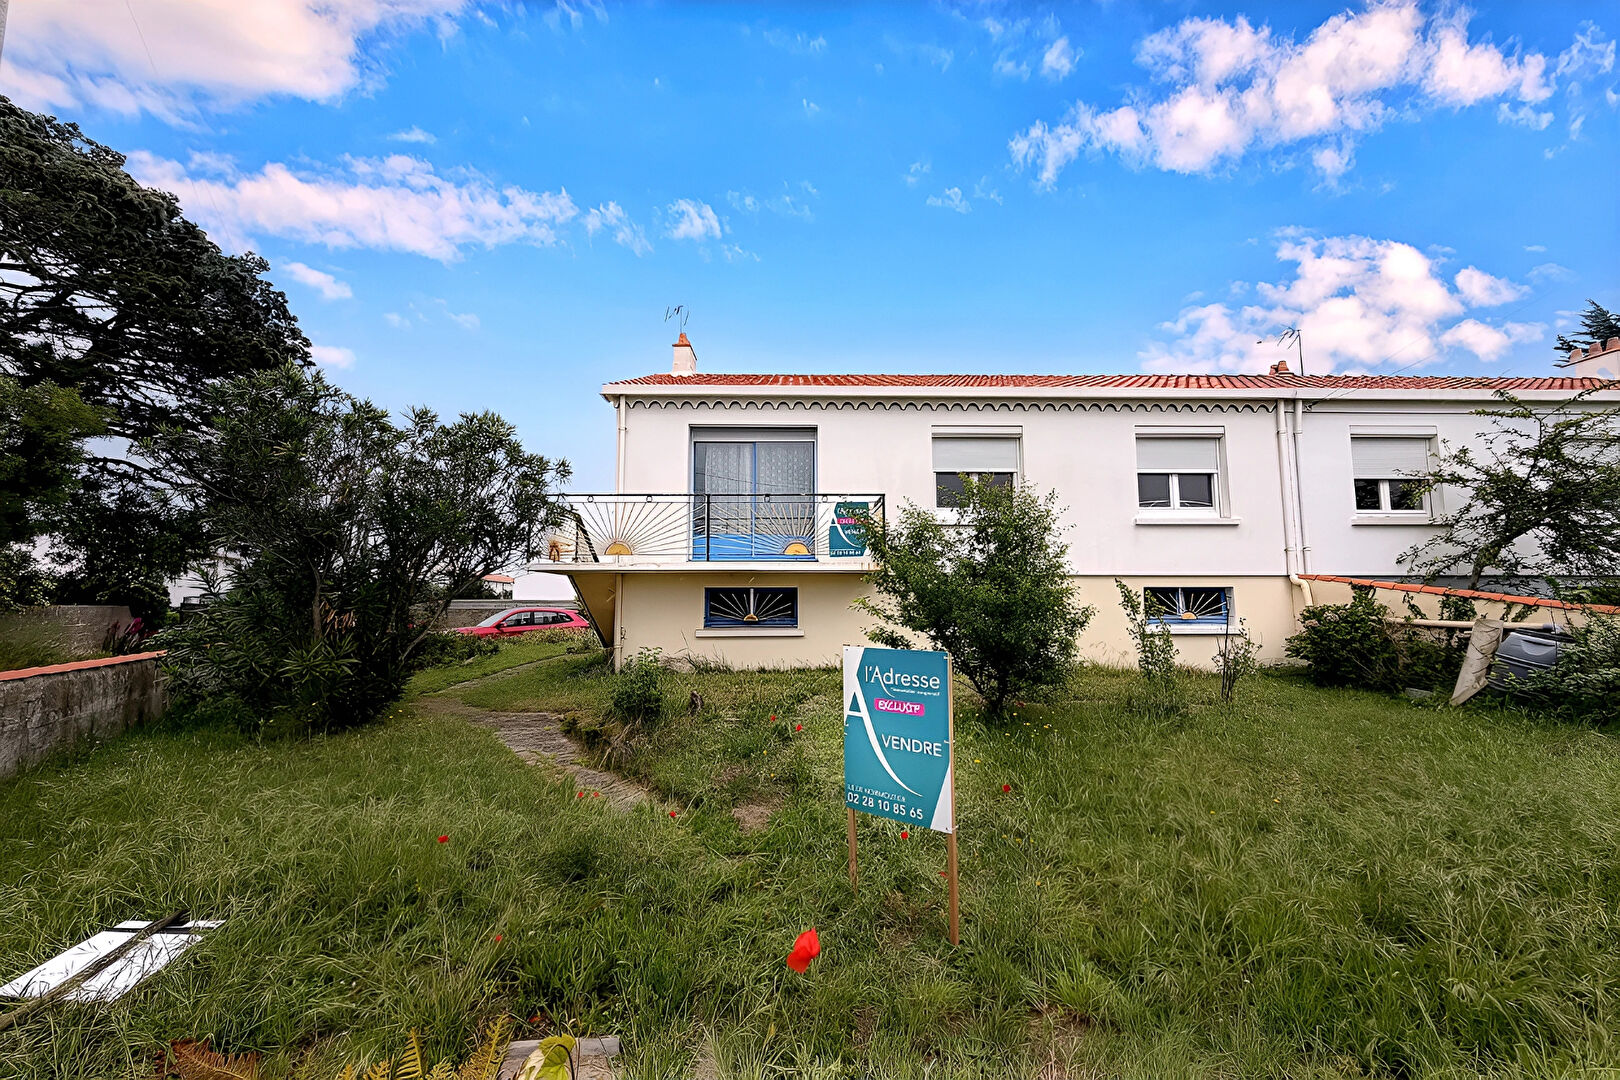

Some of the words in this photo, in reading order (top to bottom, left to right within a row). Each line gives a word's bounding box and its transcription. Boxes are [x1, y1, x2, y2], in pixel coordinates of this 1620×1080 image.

[865, 665, 940, 697] l'Adresse
[881, 733, 942, 758] VENDRE
[847, 792, 859, 804] 02
[862, 795, 874, 808] 28
[878, 799, 890, 811] 10
[893, 803, 906, 815] 85
[909, 807, 923, 820] 65
